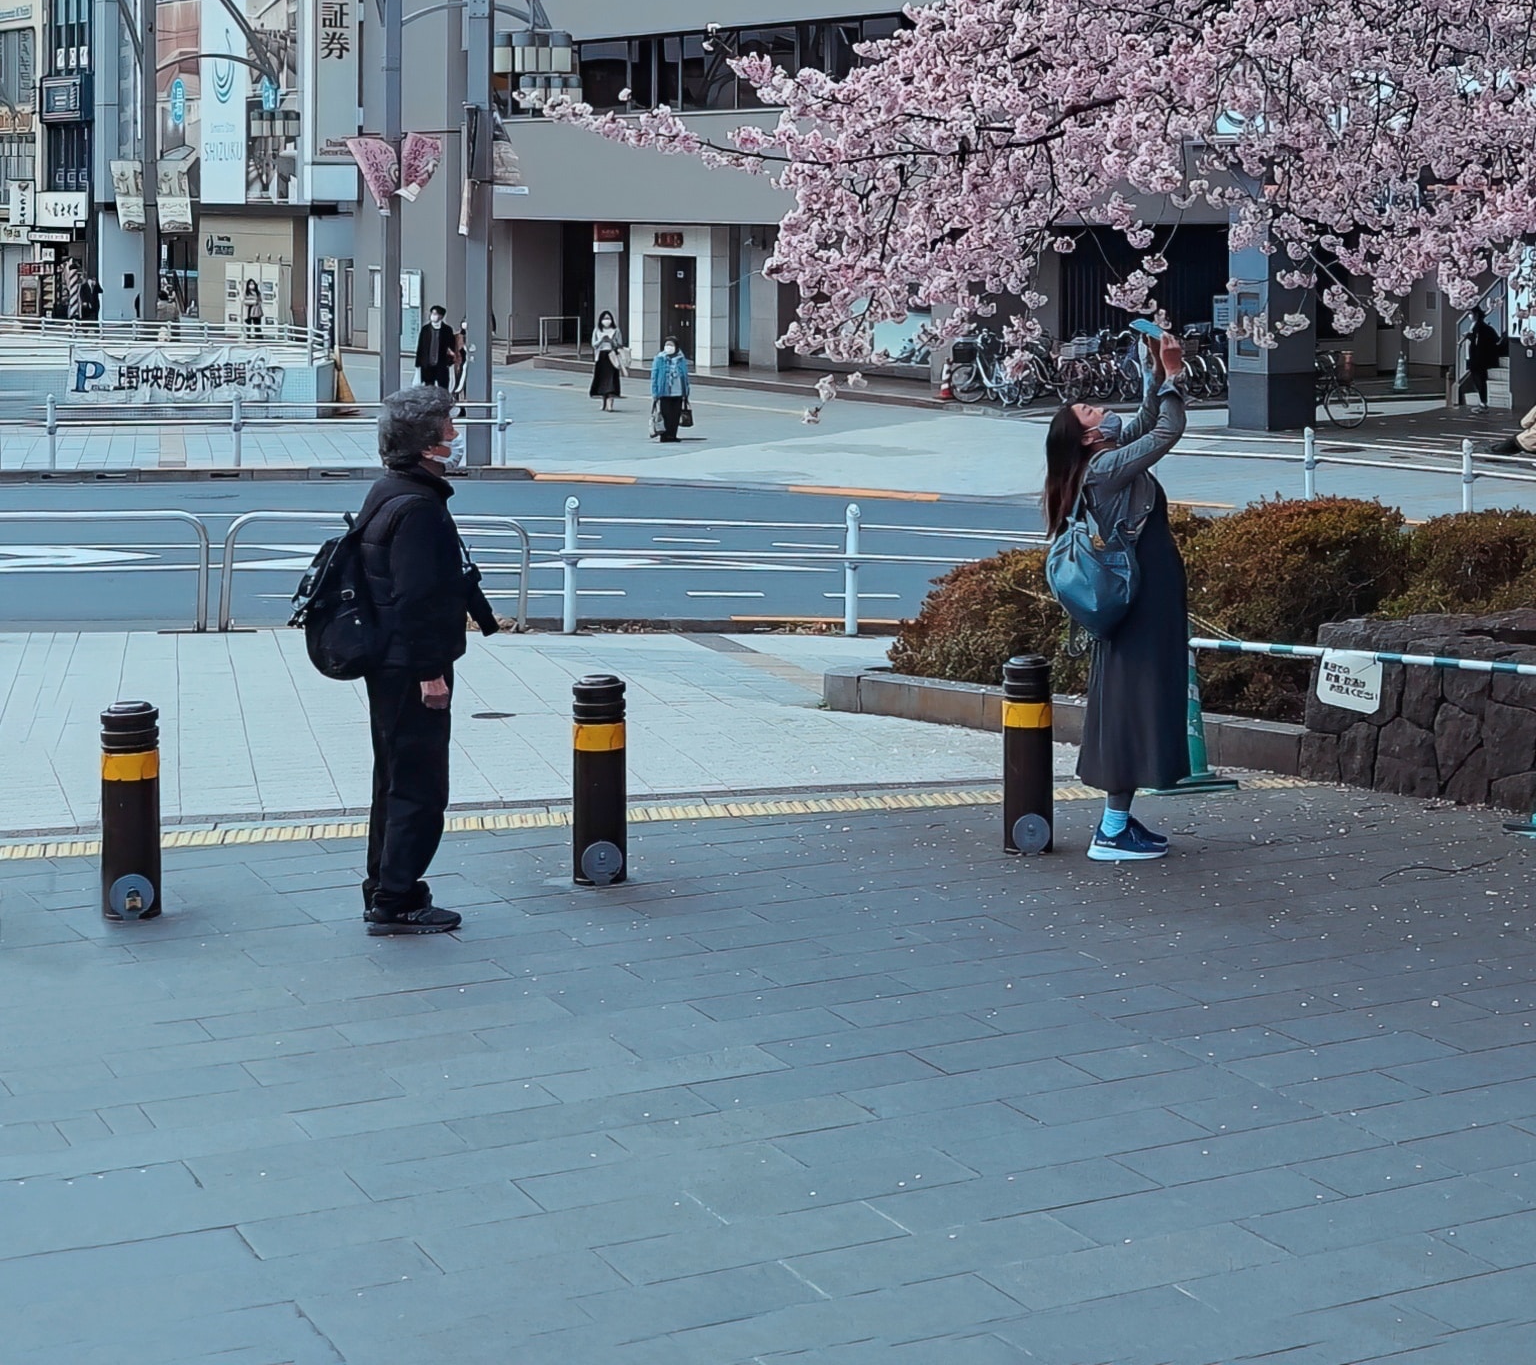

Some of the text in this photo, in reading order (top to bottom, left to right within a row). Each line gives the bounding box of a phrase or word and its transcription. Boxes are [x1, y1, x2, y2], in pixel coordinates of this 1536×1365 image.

[112, 361, 249, 392] 上野中央通り地下駐車場
